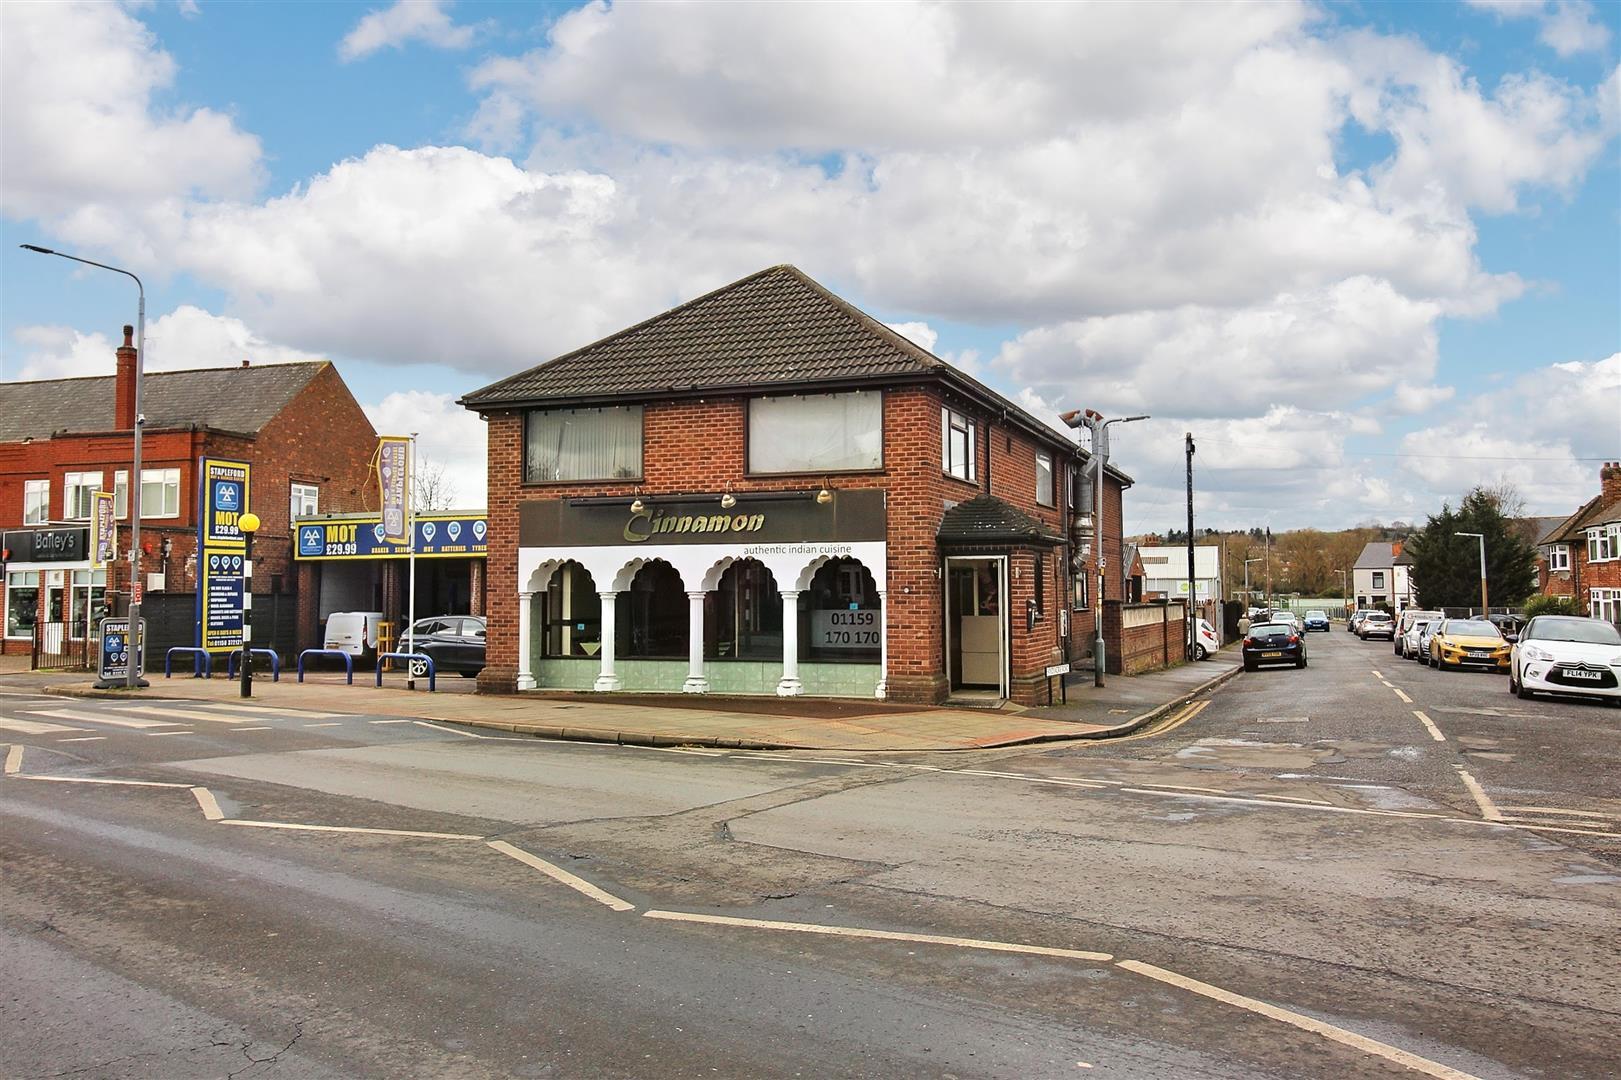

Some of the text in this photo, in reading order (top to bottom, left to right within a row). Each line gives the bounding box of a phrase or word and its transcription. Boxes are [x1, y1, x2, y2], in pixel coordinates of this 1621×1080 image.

[210, 466, 245, 478] STAPLEFORD
[215, 511, 239, 526] MOT
[215, 526, 239, 536] £29.99
[624, 509, 765, 542] Cinnamon
[326, 525, 357, 543] MOT
[35, 532, 74, 551] Bailey's
[326, 543, 357, 555] £29.99
[744, 545, 852, 555] authentic indian cuisine
[831, 613, 874, 625] 01159
[106, 624, 142, 632] STAPLED
[825, 632, 880, 644] 170 170
